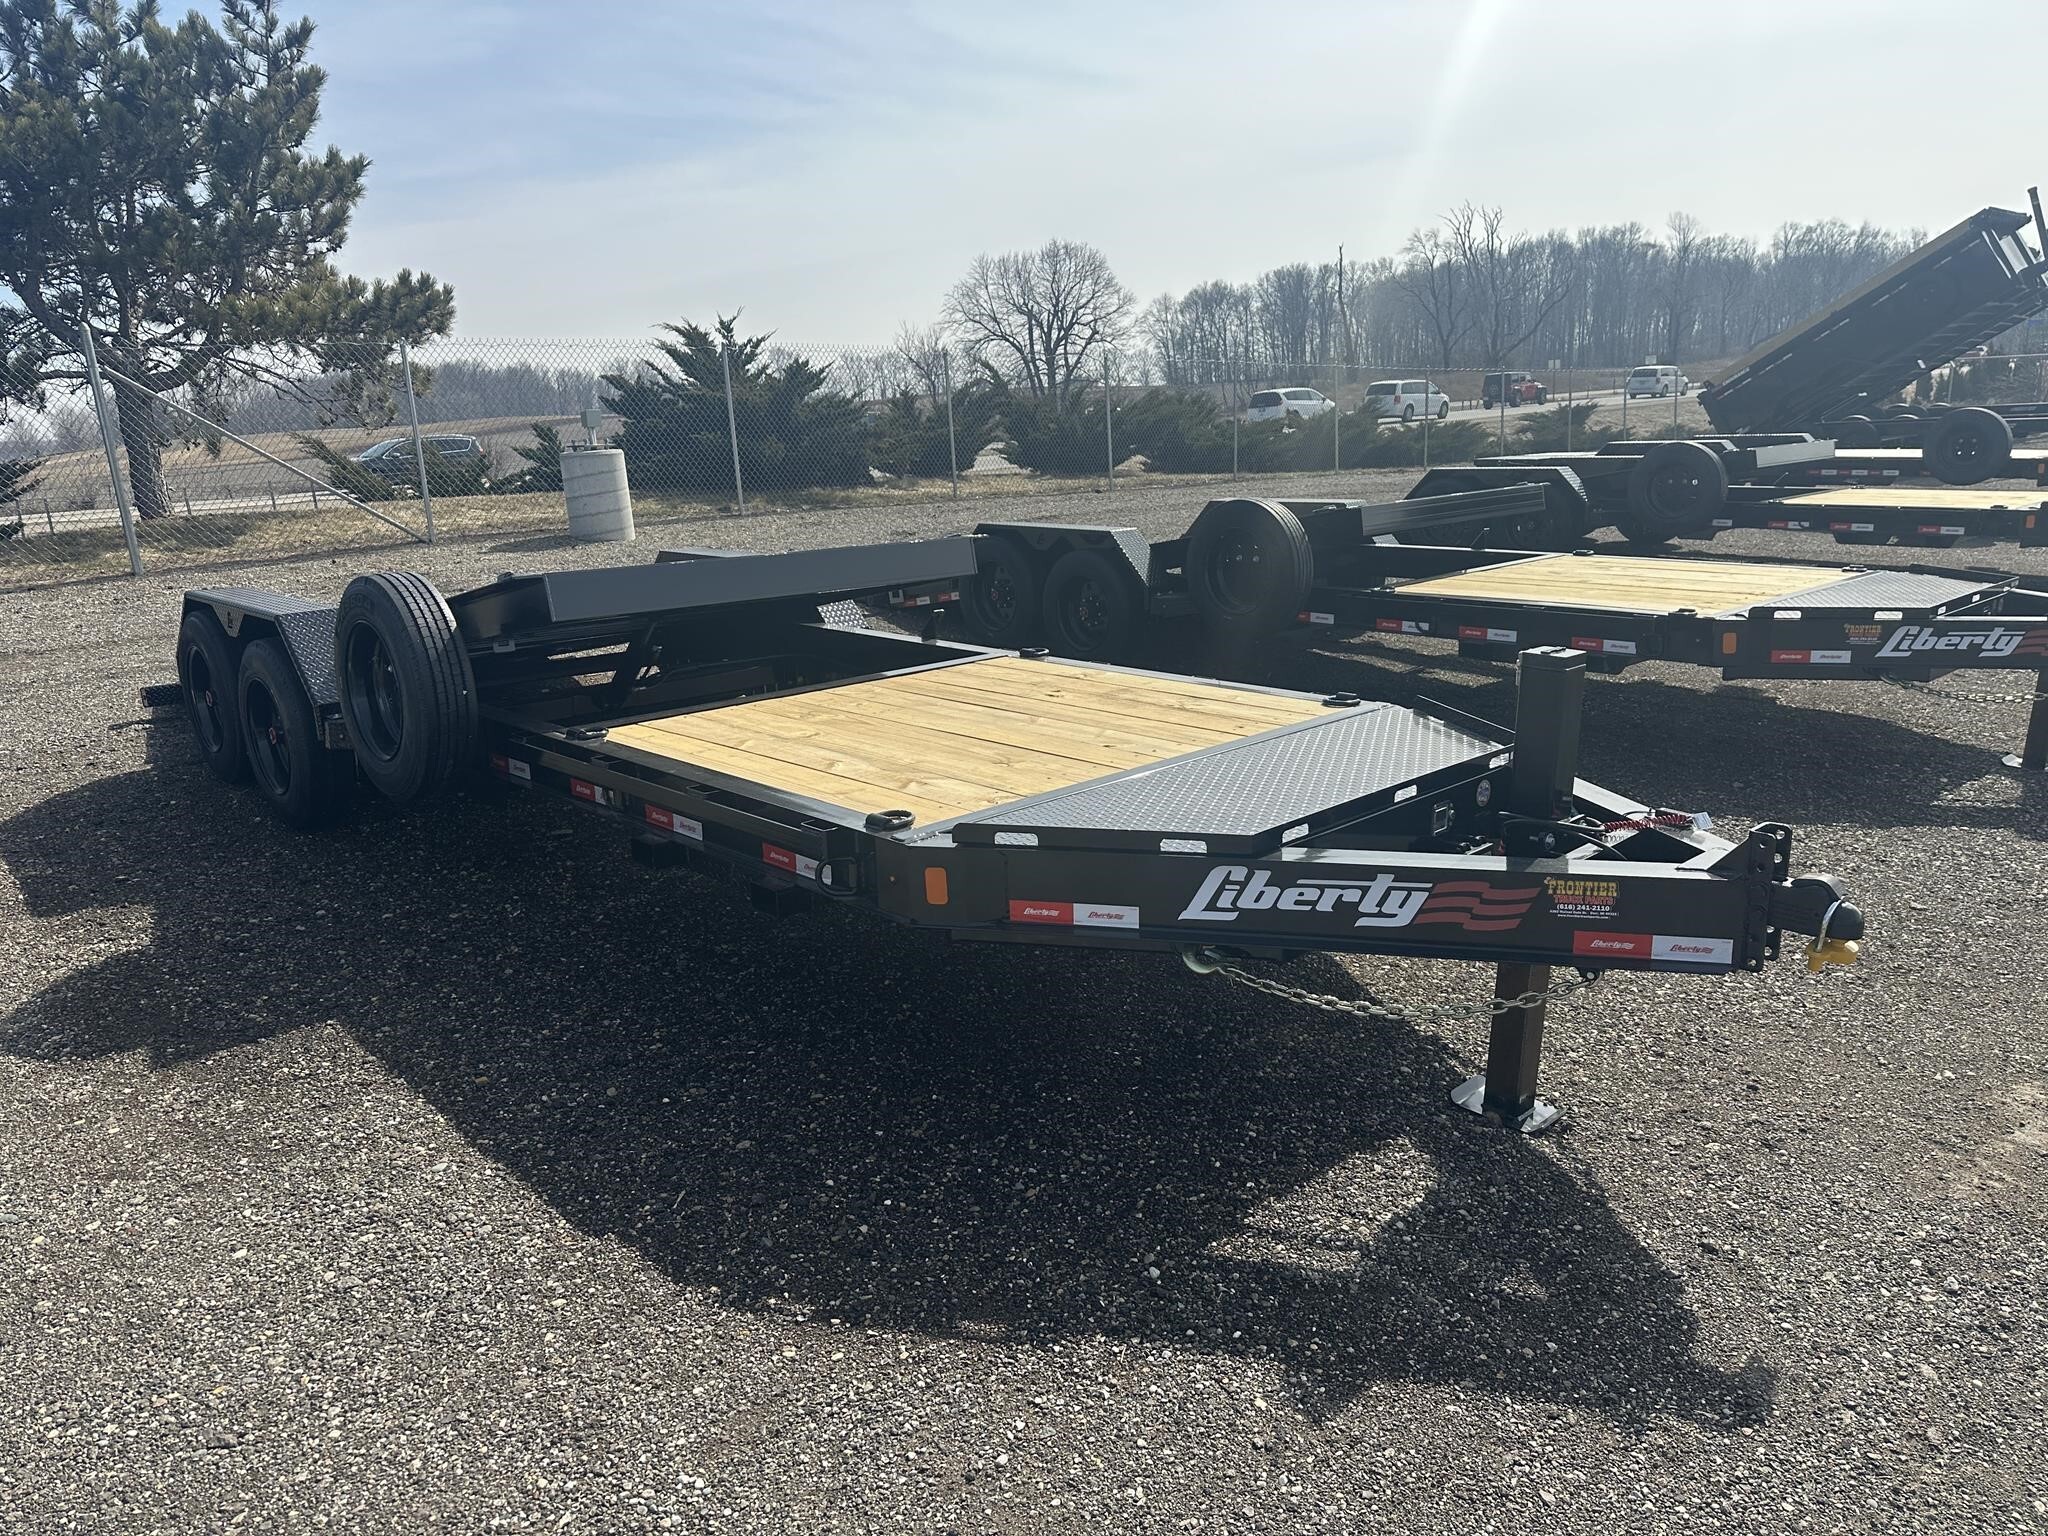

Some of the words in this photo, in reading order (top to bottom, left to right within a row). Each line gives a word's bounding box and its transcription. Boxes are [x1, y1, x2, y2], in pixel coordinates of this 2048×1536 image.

[1874, 625, 2026, 657] Liberty
[1547, 880, 1617, 897] FRONTIER
[1177, 865, 1433, 927] Liberty
[1556, 903, 1575, 911] (616)
[1590, 939, 1622, 949] Liberty
[1669, 944, 1701, 954] Liberty
